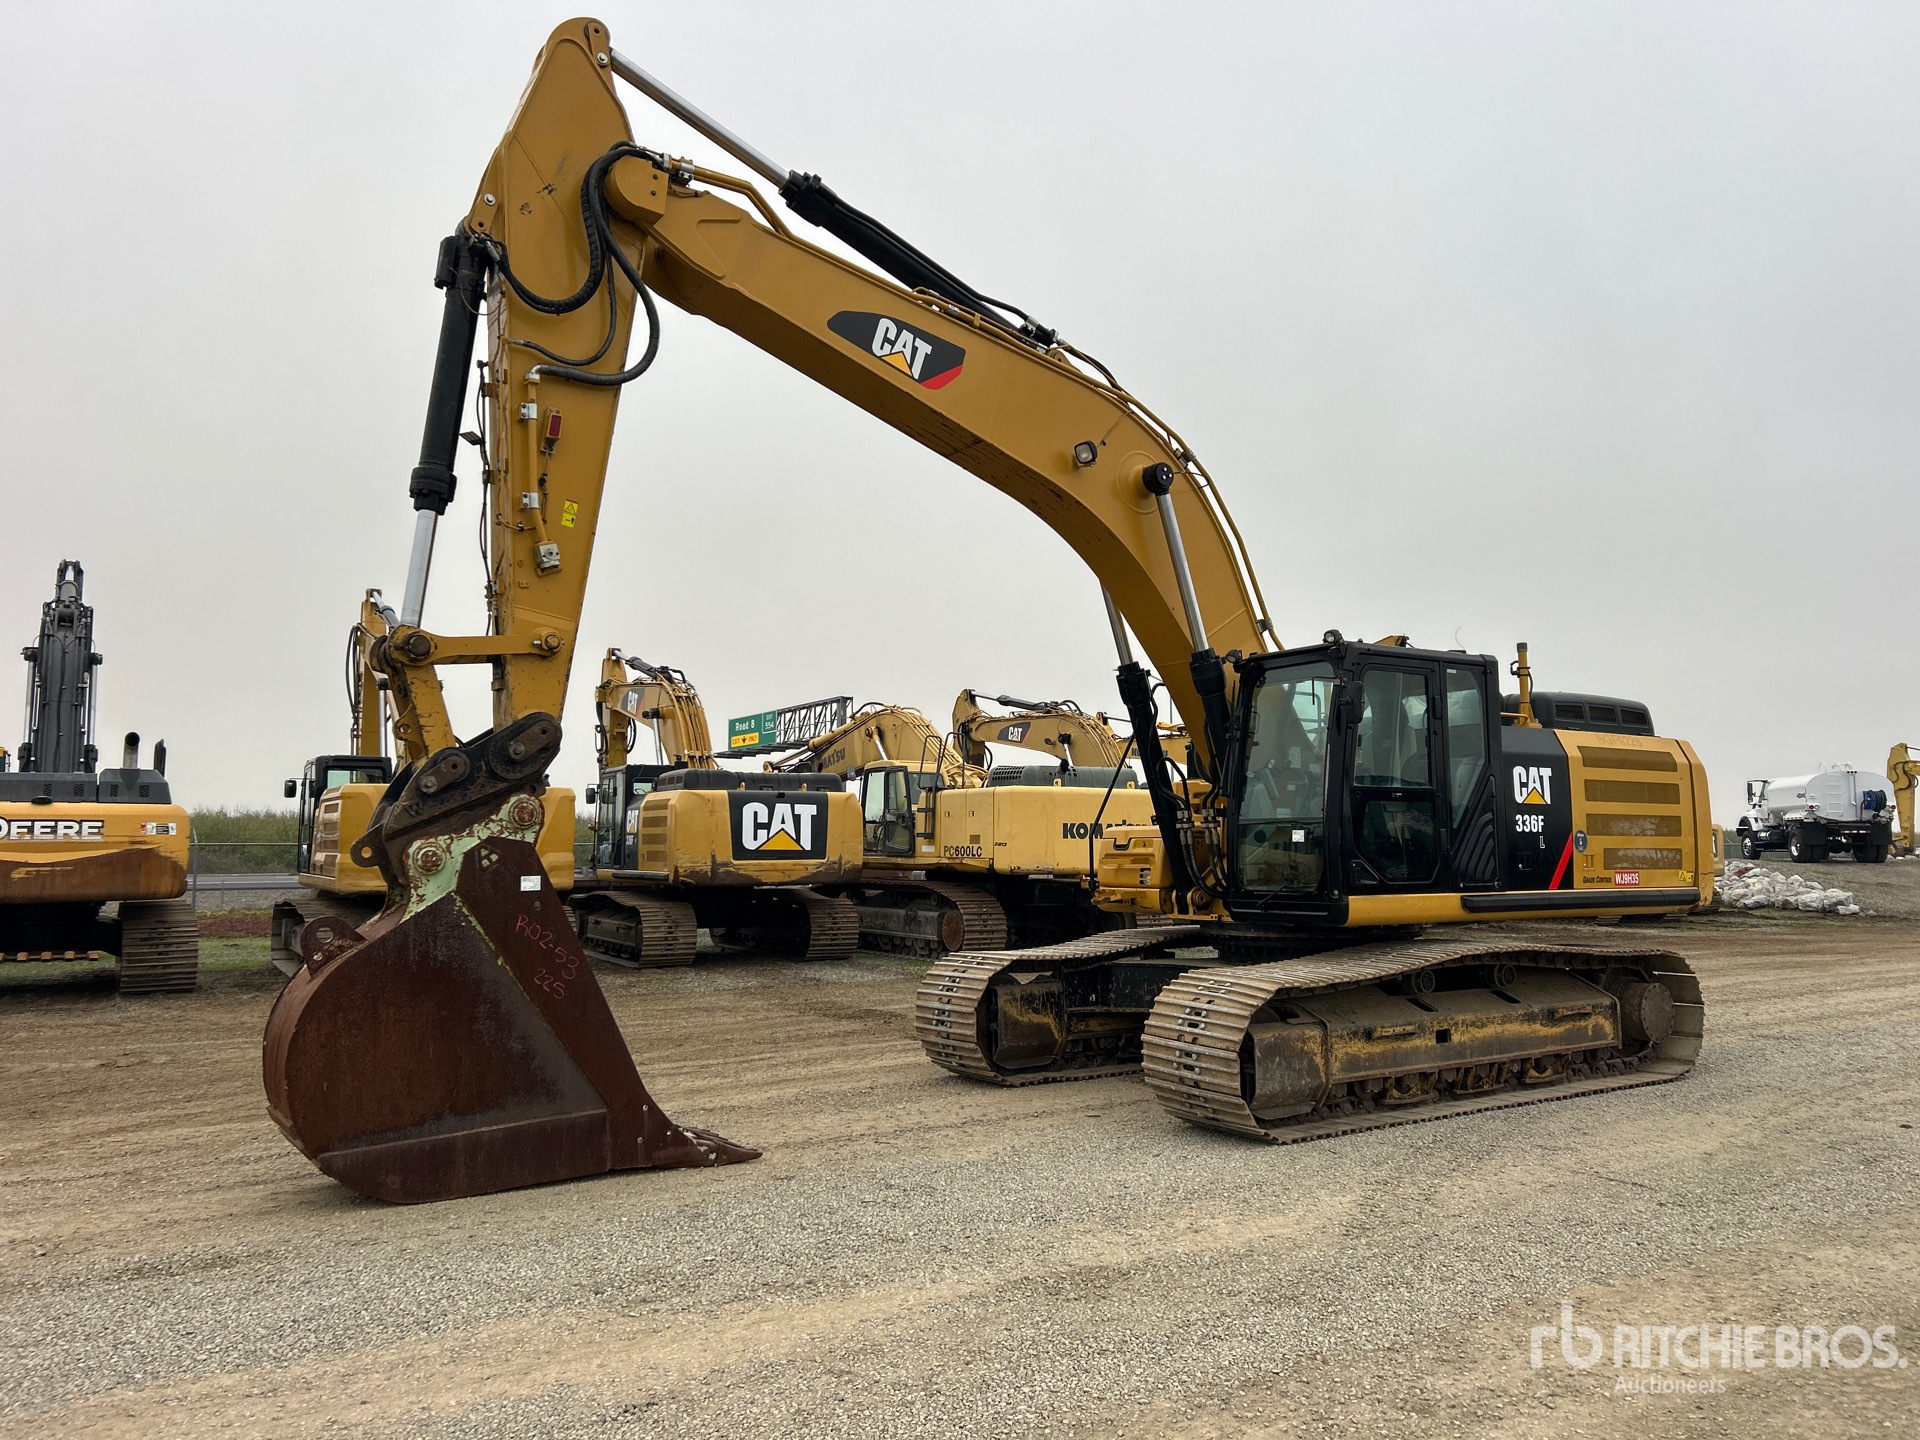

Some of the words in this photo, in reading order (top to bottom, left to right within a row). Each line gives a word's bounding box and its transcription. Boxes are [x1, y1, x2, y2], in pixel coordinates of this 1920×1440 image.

[871, 318, 933, 380] CAT
[627, 690, 638, 715] CAT
[735, 721, 749, 731] Road
[764, 721, 774, 730] 554
[1008, 726, 1022, 741] CAT
[1513, 765, 1552, 805] CAT
[627, 810, 638, 833] CAT
[742, 802, 817, 850] CAT
[1516, 814, 1544, 832] 336F
[1540, 836, 1546, 848] L
[944, 846, 982, 857] PC600LC
[1615, 873, 1639, 884] WJ9H35
